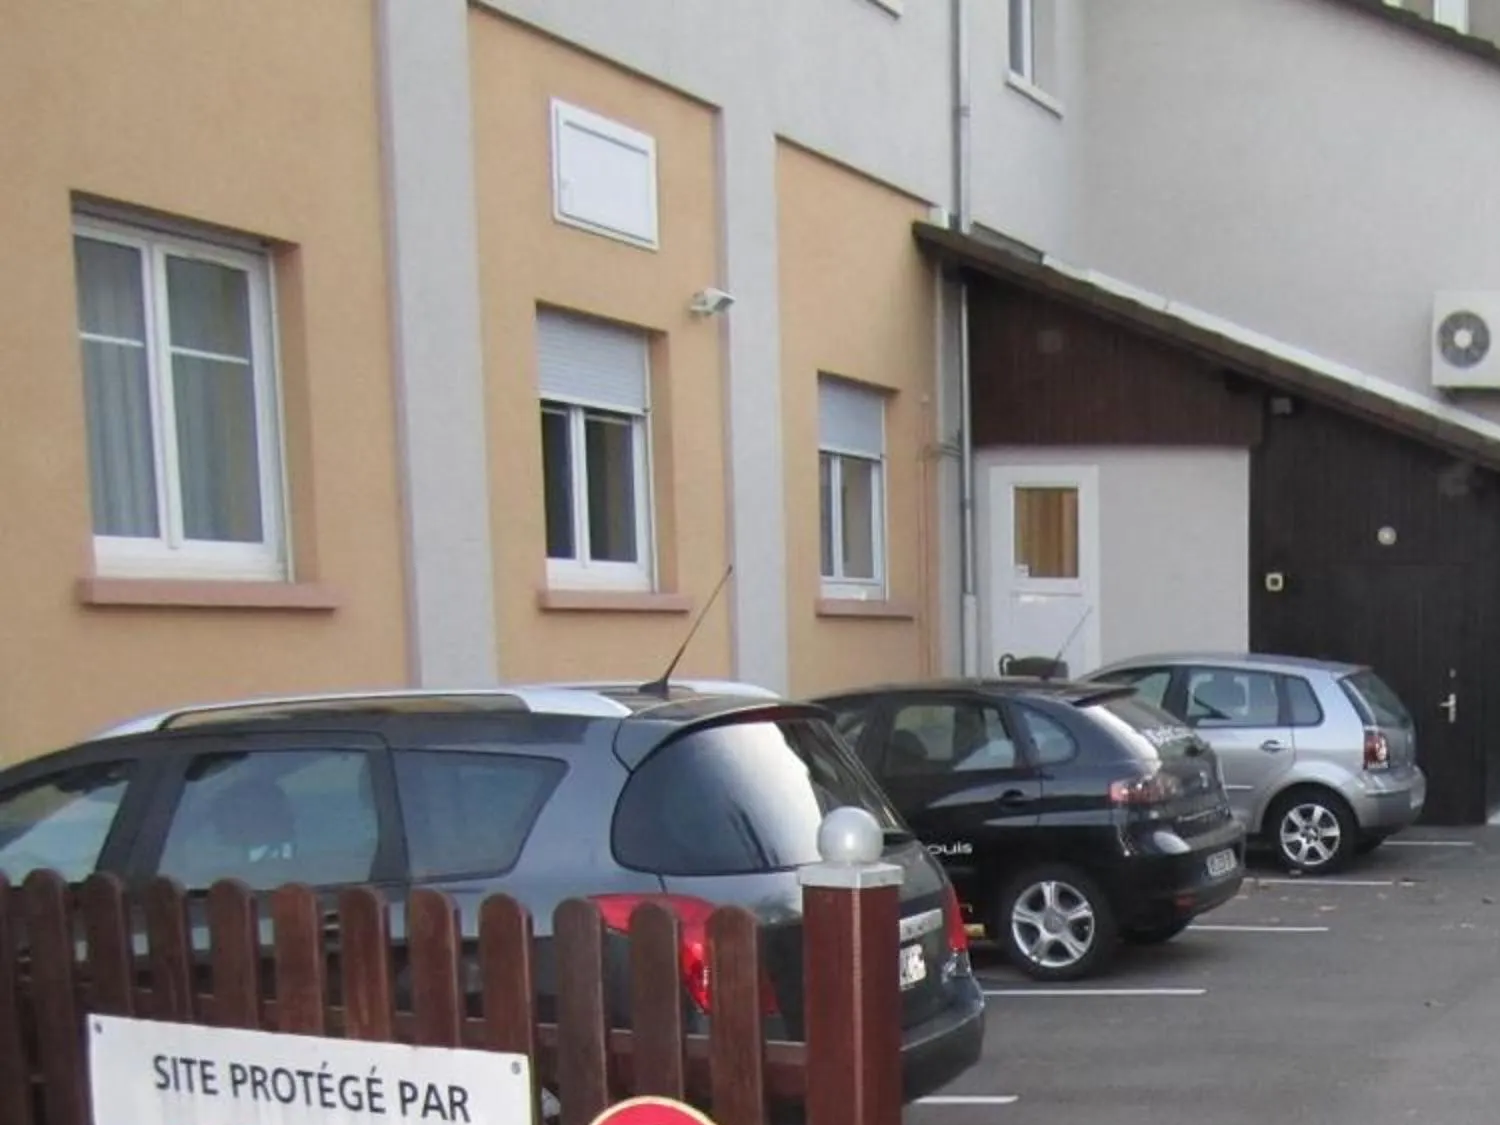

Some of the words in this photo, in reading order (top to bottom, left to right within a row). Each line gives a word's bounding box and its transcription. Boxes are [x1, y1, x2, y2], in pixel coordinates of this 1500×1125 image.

[926, 840, 974, 856] ouis
[153, 1054, 219, 1096] SITE
[229, 1061, 387, 1115] PROTÉGÉ
[397, 1080, 472, 1124] PAR
